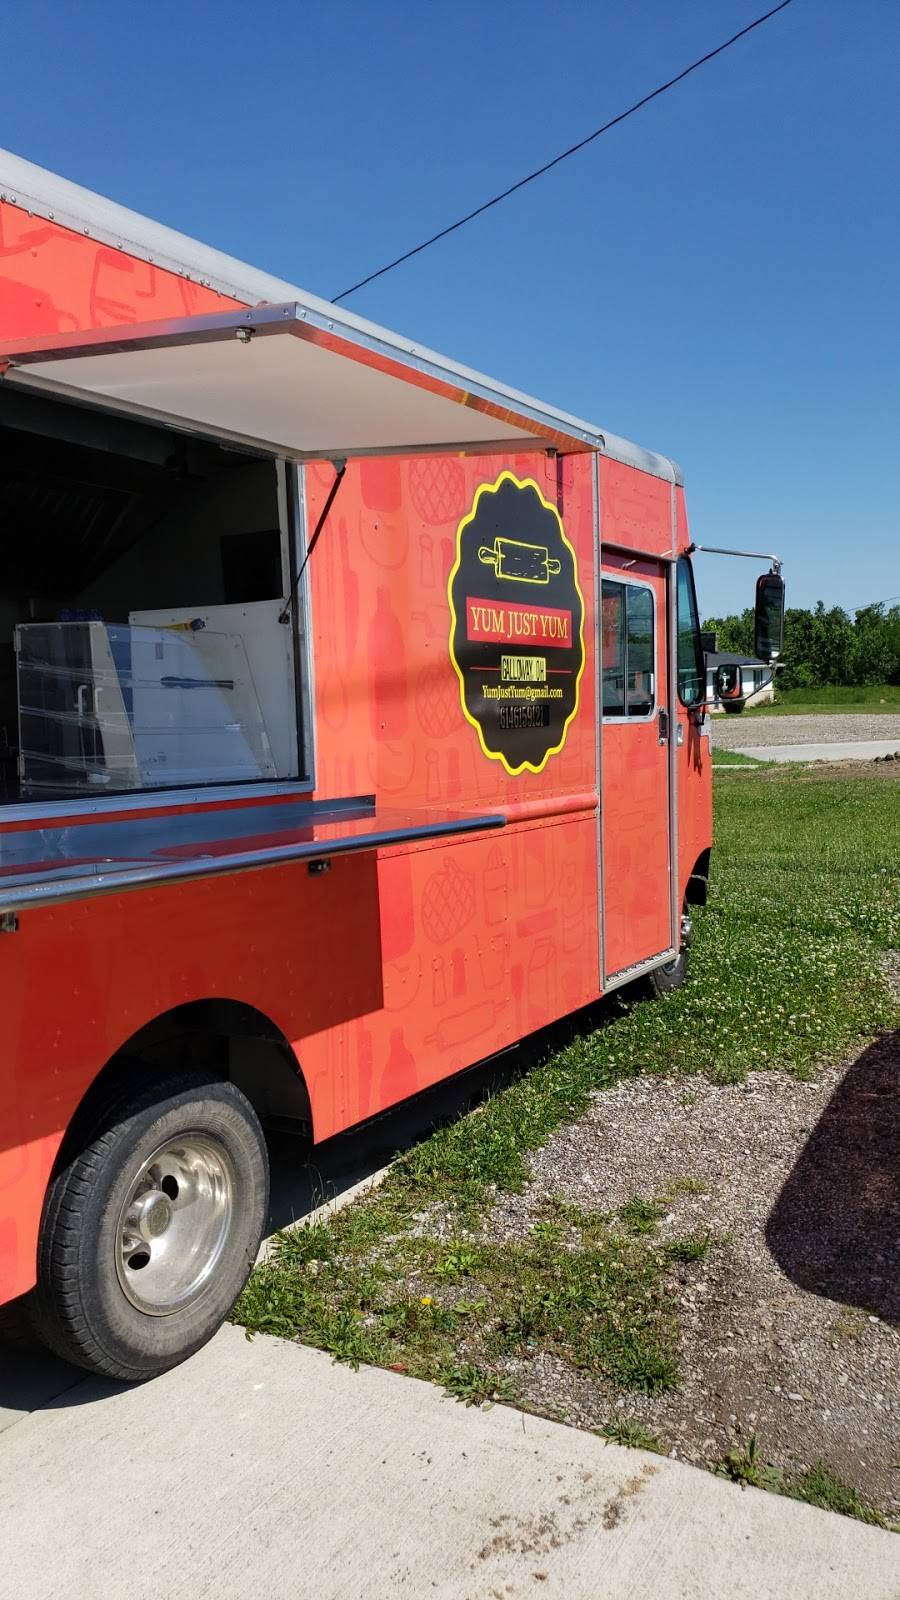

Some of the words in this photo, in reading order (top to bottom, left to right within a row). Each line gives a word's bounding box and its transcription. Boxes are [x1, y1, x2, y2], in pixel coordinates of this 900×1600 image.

[470, 606, 505, 634] YUM
[507, 611, 539, 639] JUST
[539, 615, 568, 639] YUM
[482, 685, 563, 701] YumJustYum@gmail.com
